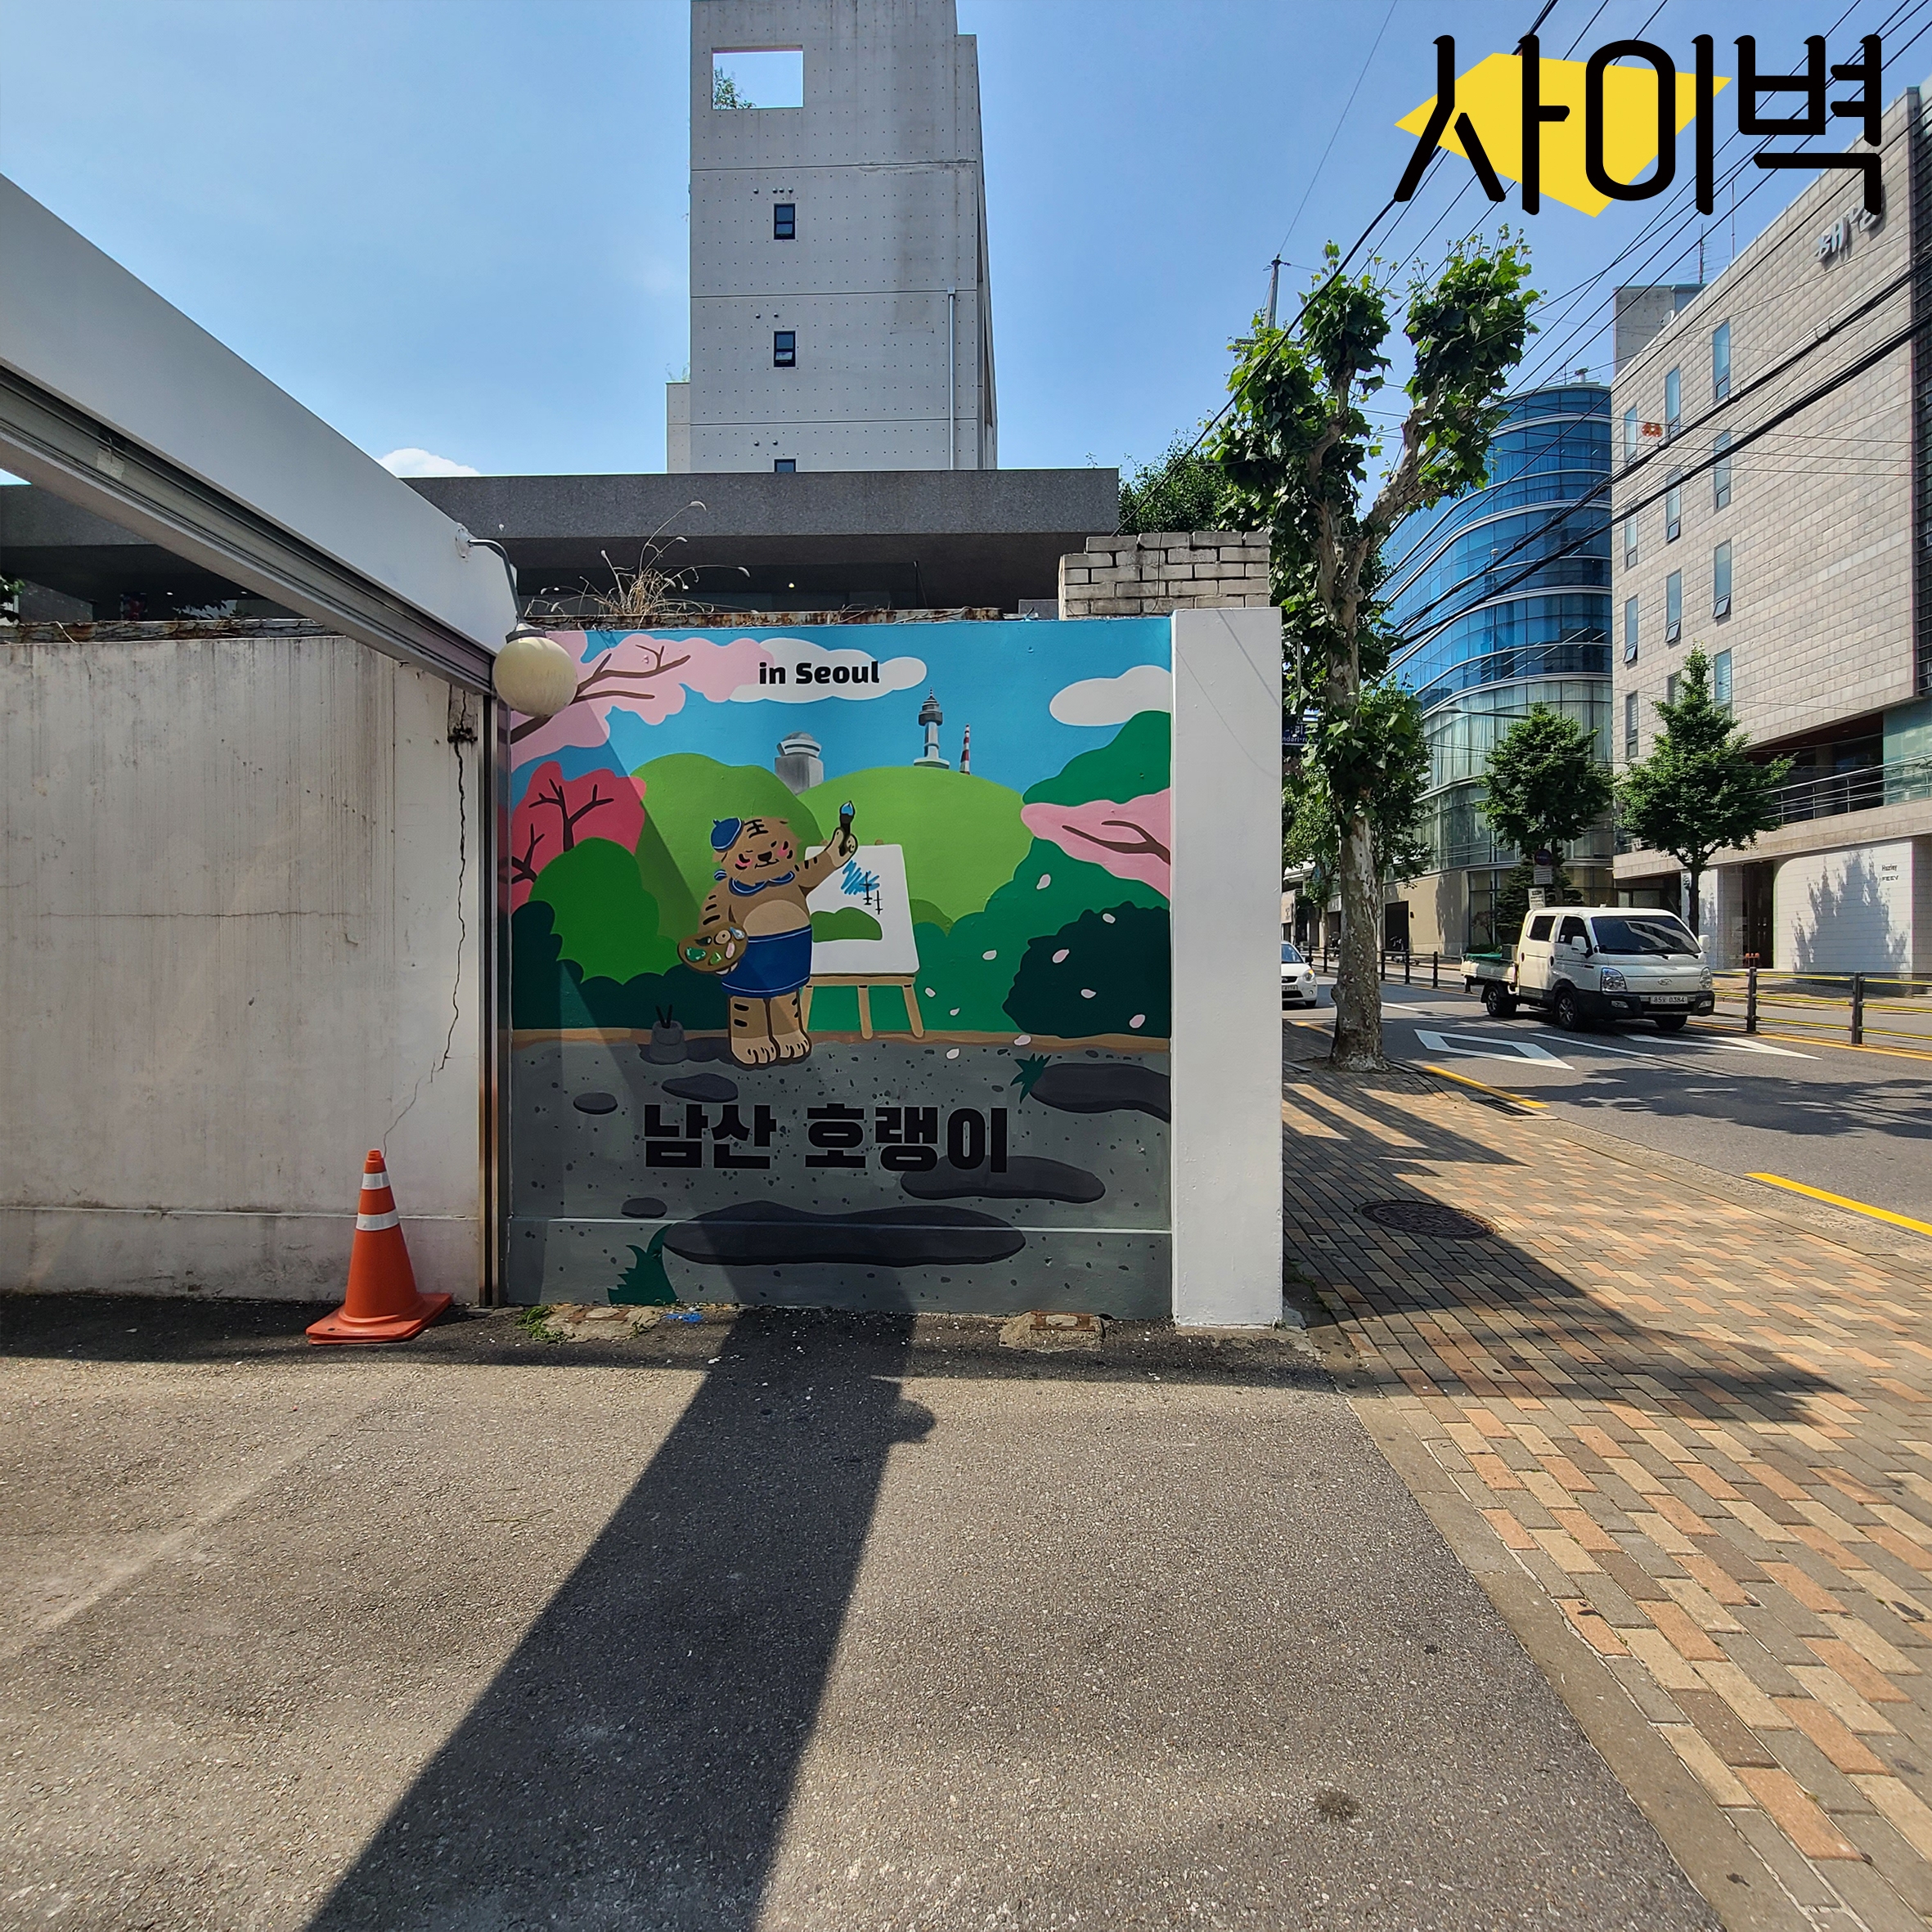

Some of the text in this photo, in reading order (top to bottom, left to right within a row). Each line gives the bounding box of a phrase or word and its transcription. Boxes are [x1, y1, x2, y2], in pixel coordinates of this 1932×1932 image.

[759, 661, 880, 685] in Seoul
[644, 1103, 1008, 1173] 남산 호랭이
